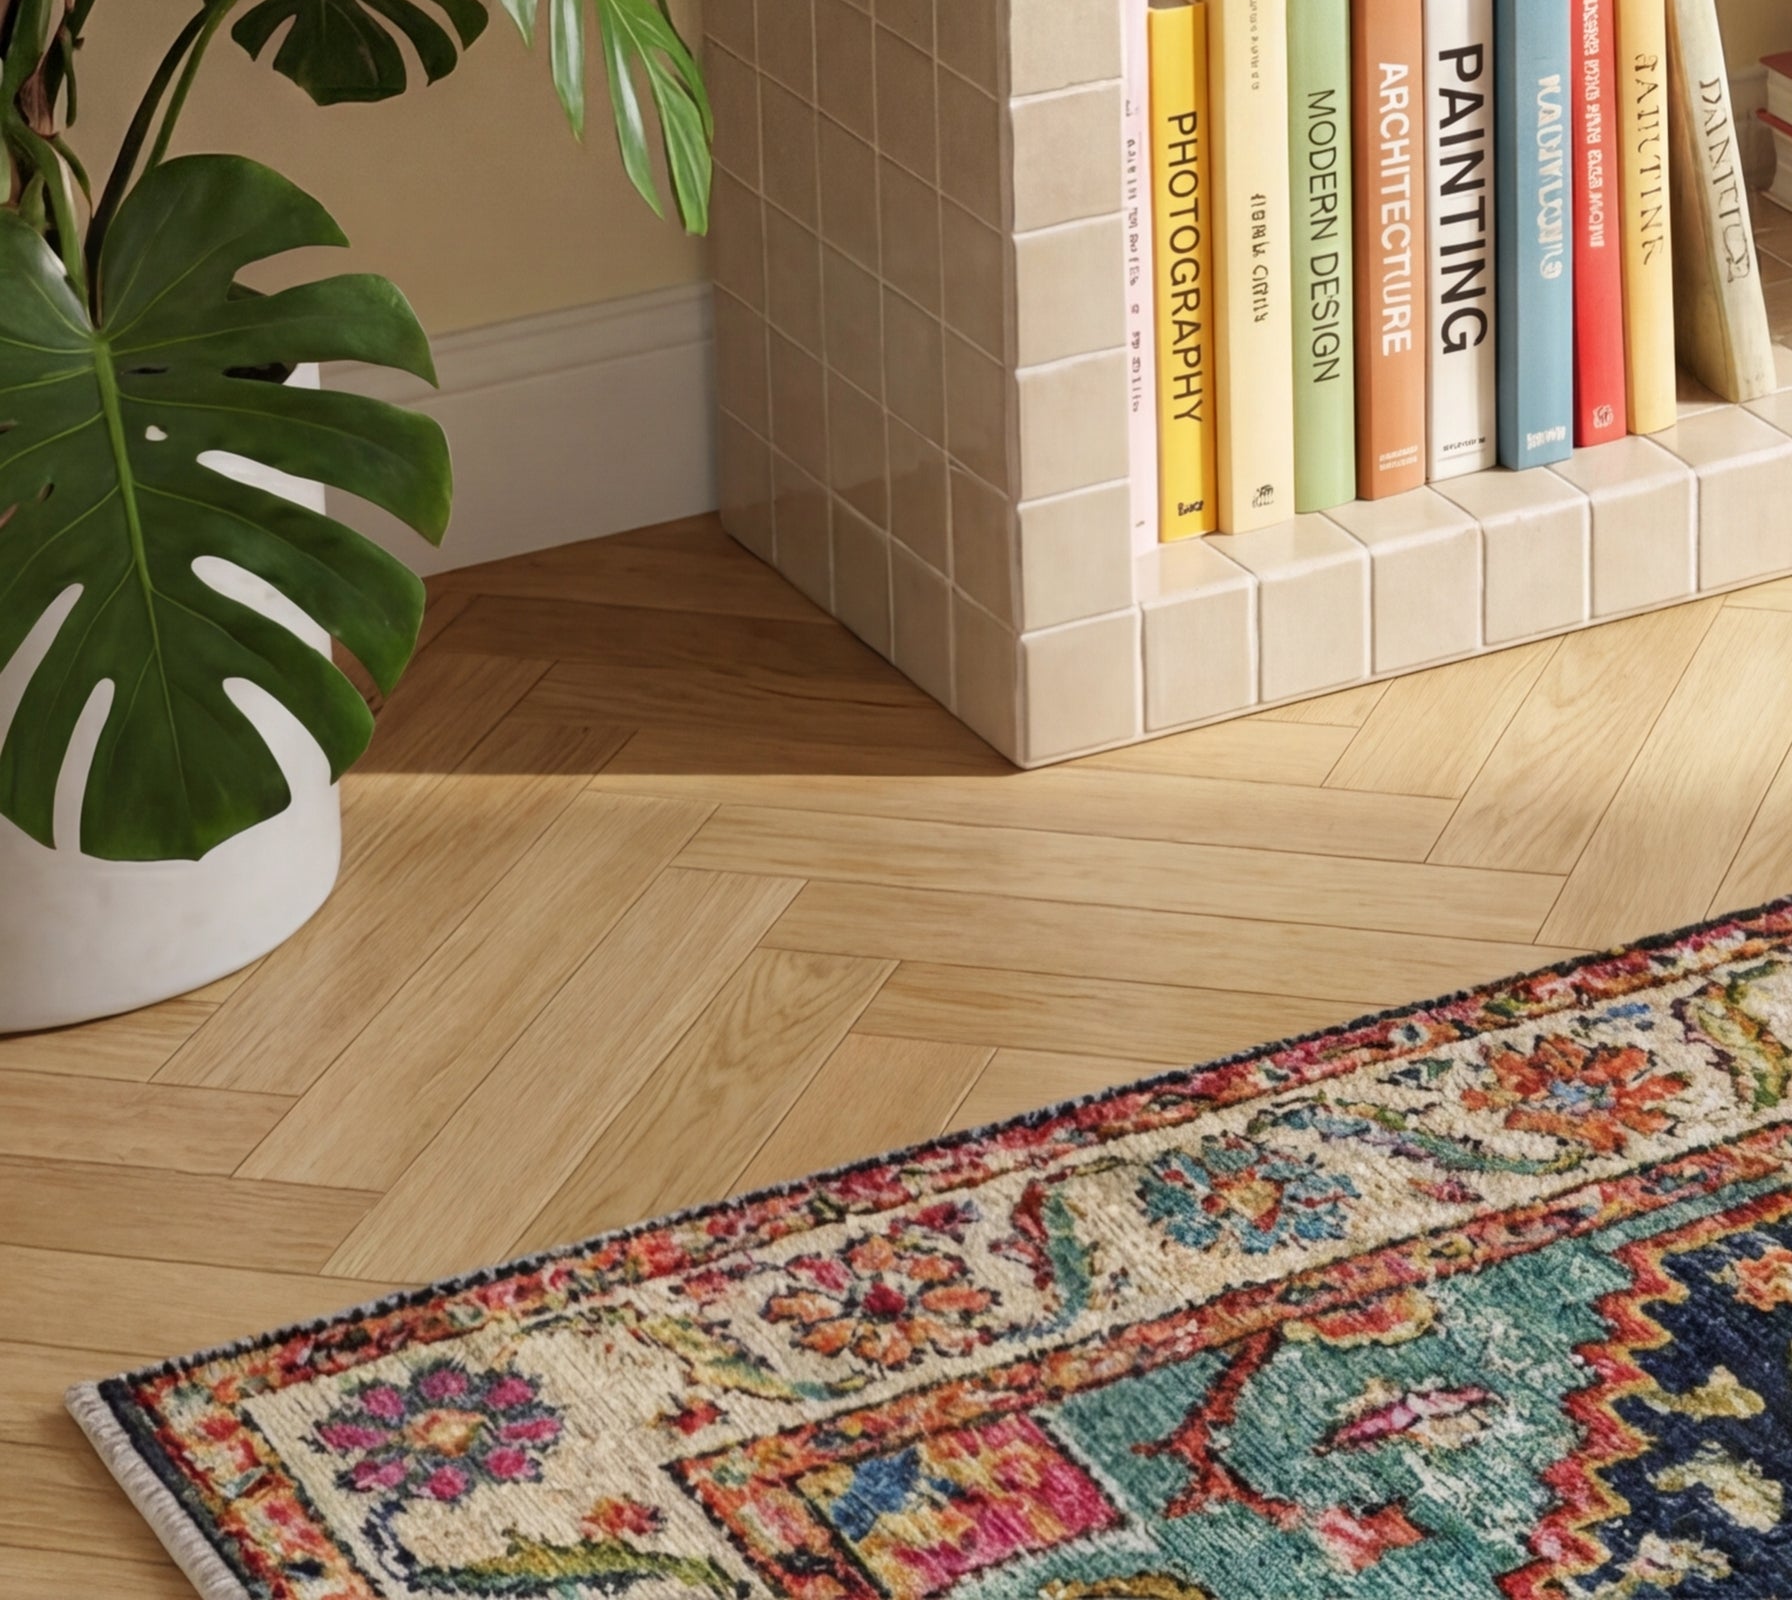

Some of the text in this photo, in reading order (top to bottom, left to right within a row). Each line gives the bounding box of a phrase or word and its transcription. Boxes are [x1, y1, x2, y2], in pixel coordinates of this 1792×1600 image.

[1168, 111, 1204, 423] PHOTOGRAPHY
[1307, 89, 1341, 384] MODERN DESIGN
[1378, 62, 1412, 357] ARCHITECTURE
[1438, 43, 1488, 355] PAINTING
